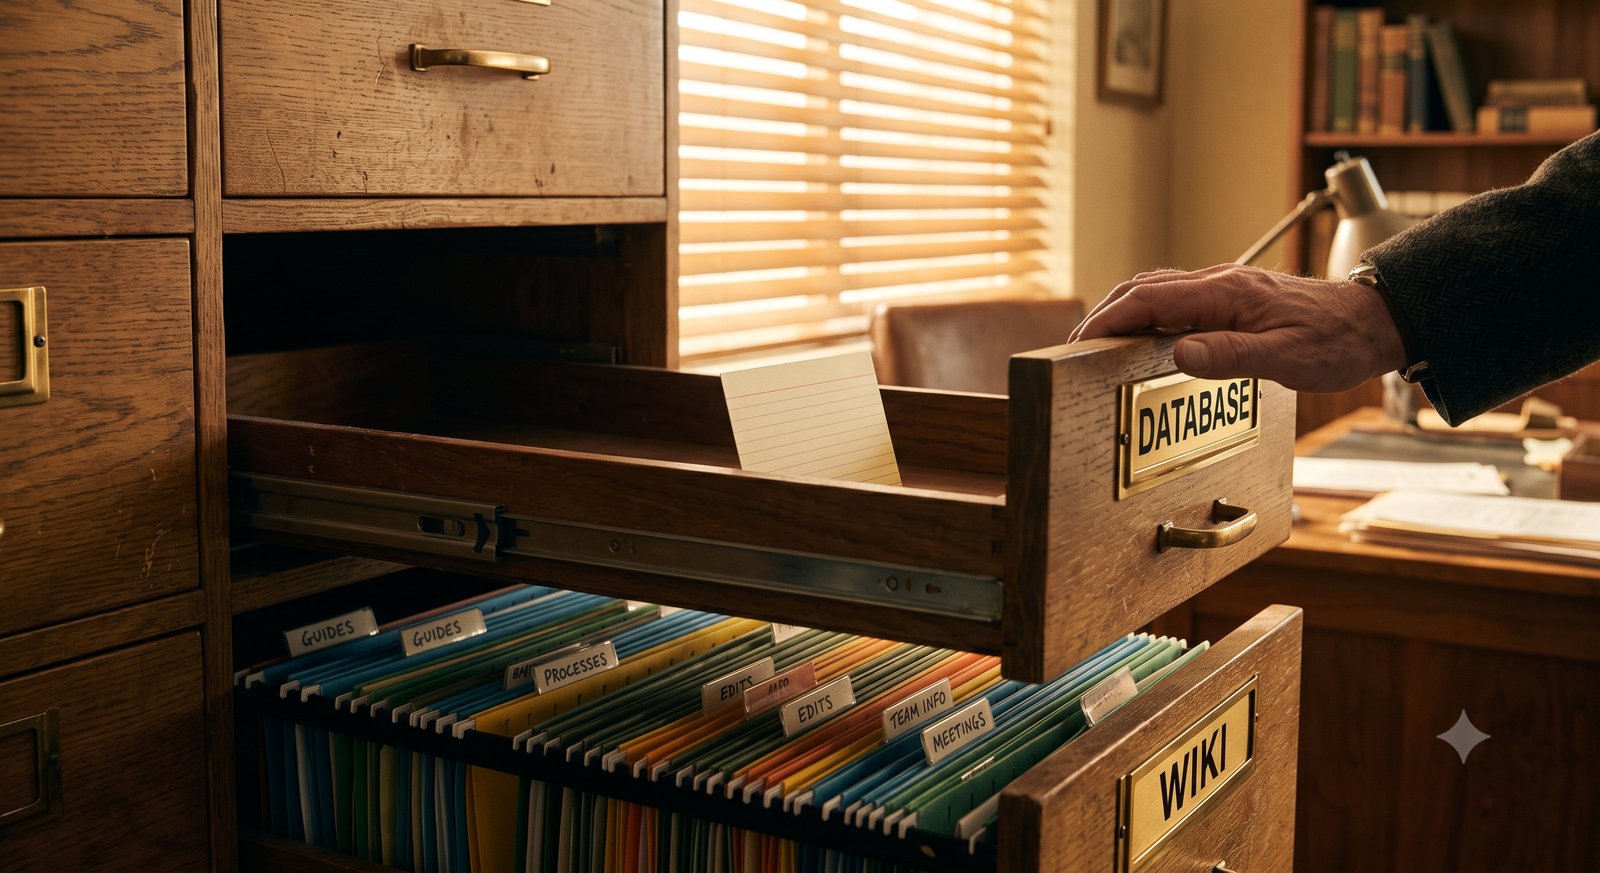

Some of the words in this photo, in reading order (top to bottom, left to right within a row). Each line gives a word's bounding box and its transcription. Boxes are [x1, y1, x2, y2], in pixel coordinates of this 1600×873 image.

[1138, 378, 1251, 456] DATABASE
[301, 620, 355, 647] GUIDES
[412, 620, 462, 647] GUIDES
[544, 652, 608, 686] PROCESSES
[797, 694, 833, 724] EDITS
[889, 702, 920, 730] TEAM
[922, 691, 946, 714] INFO
[932, 711, 986, 753] MEETINGS
[1159, 722, 1227, 822] WIKI
